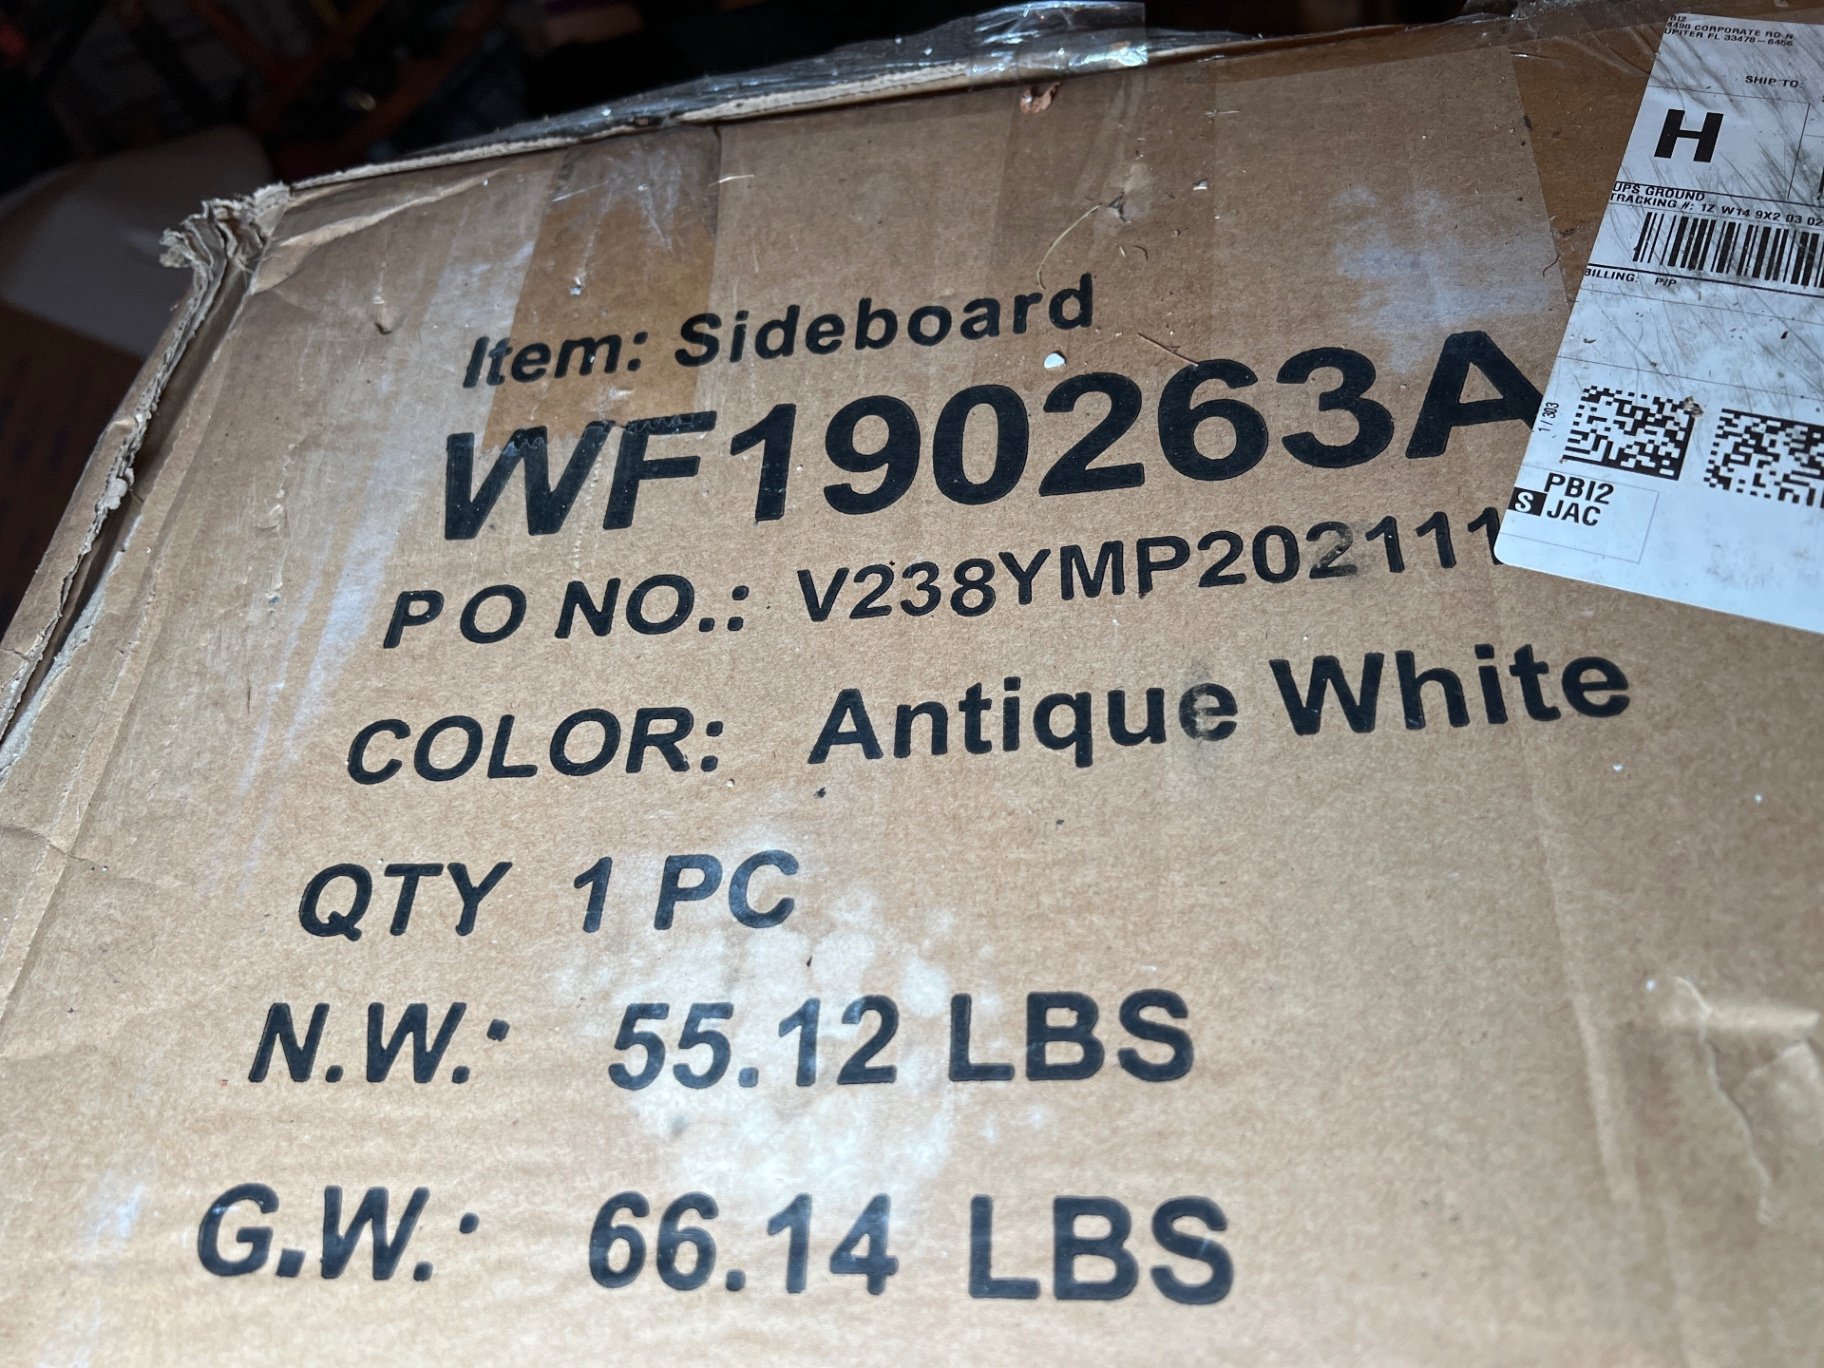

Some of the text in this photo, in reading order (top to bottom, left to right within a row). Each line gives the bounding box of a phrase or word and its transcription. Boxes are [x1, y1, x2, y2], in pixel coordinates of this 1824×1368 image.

[1694, 25, 1760, 37] CORPORATE
[1765, 31, 1781, 39] RD
[1745, 75, 1777, 86] SHIP
[1653, 109, 1724, 163] H
[1610, 192, 1678, 209] TRACKING
[1701, 203, 1716, 213] 1Z
[1721, 205, 1751, 217] W14
[1755, 210, 1781, 221] 9X2
[1785, 214, 1802, 224] 03
[1612, 182, 1706, 201] UPS GROUND
[462, 271, 1094, 389] Item: Sideboard
[445, 330, 1542, 541] WF190263A
[1514, 491, 1534, 513] S
[1544, 472, 1615, 505] PBI2
[1546, 499, 1601, 526] JAC
[554, 574, 750, 639] NO.:
[346, 643, 1632, 785] COLOR: Antique White
[298, 849, 800, 942] QTY 1 PC
[607, 994, 898, 1090] 55.12
[948, 988, 1195, 1083] LBS
[587, 1190, 899, 1294] 66.14
[969, 1195, 1234, 1306] LBS
